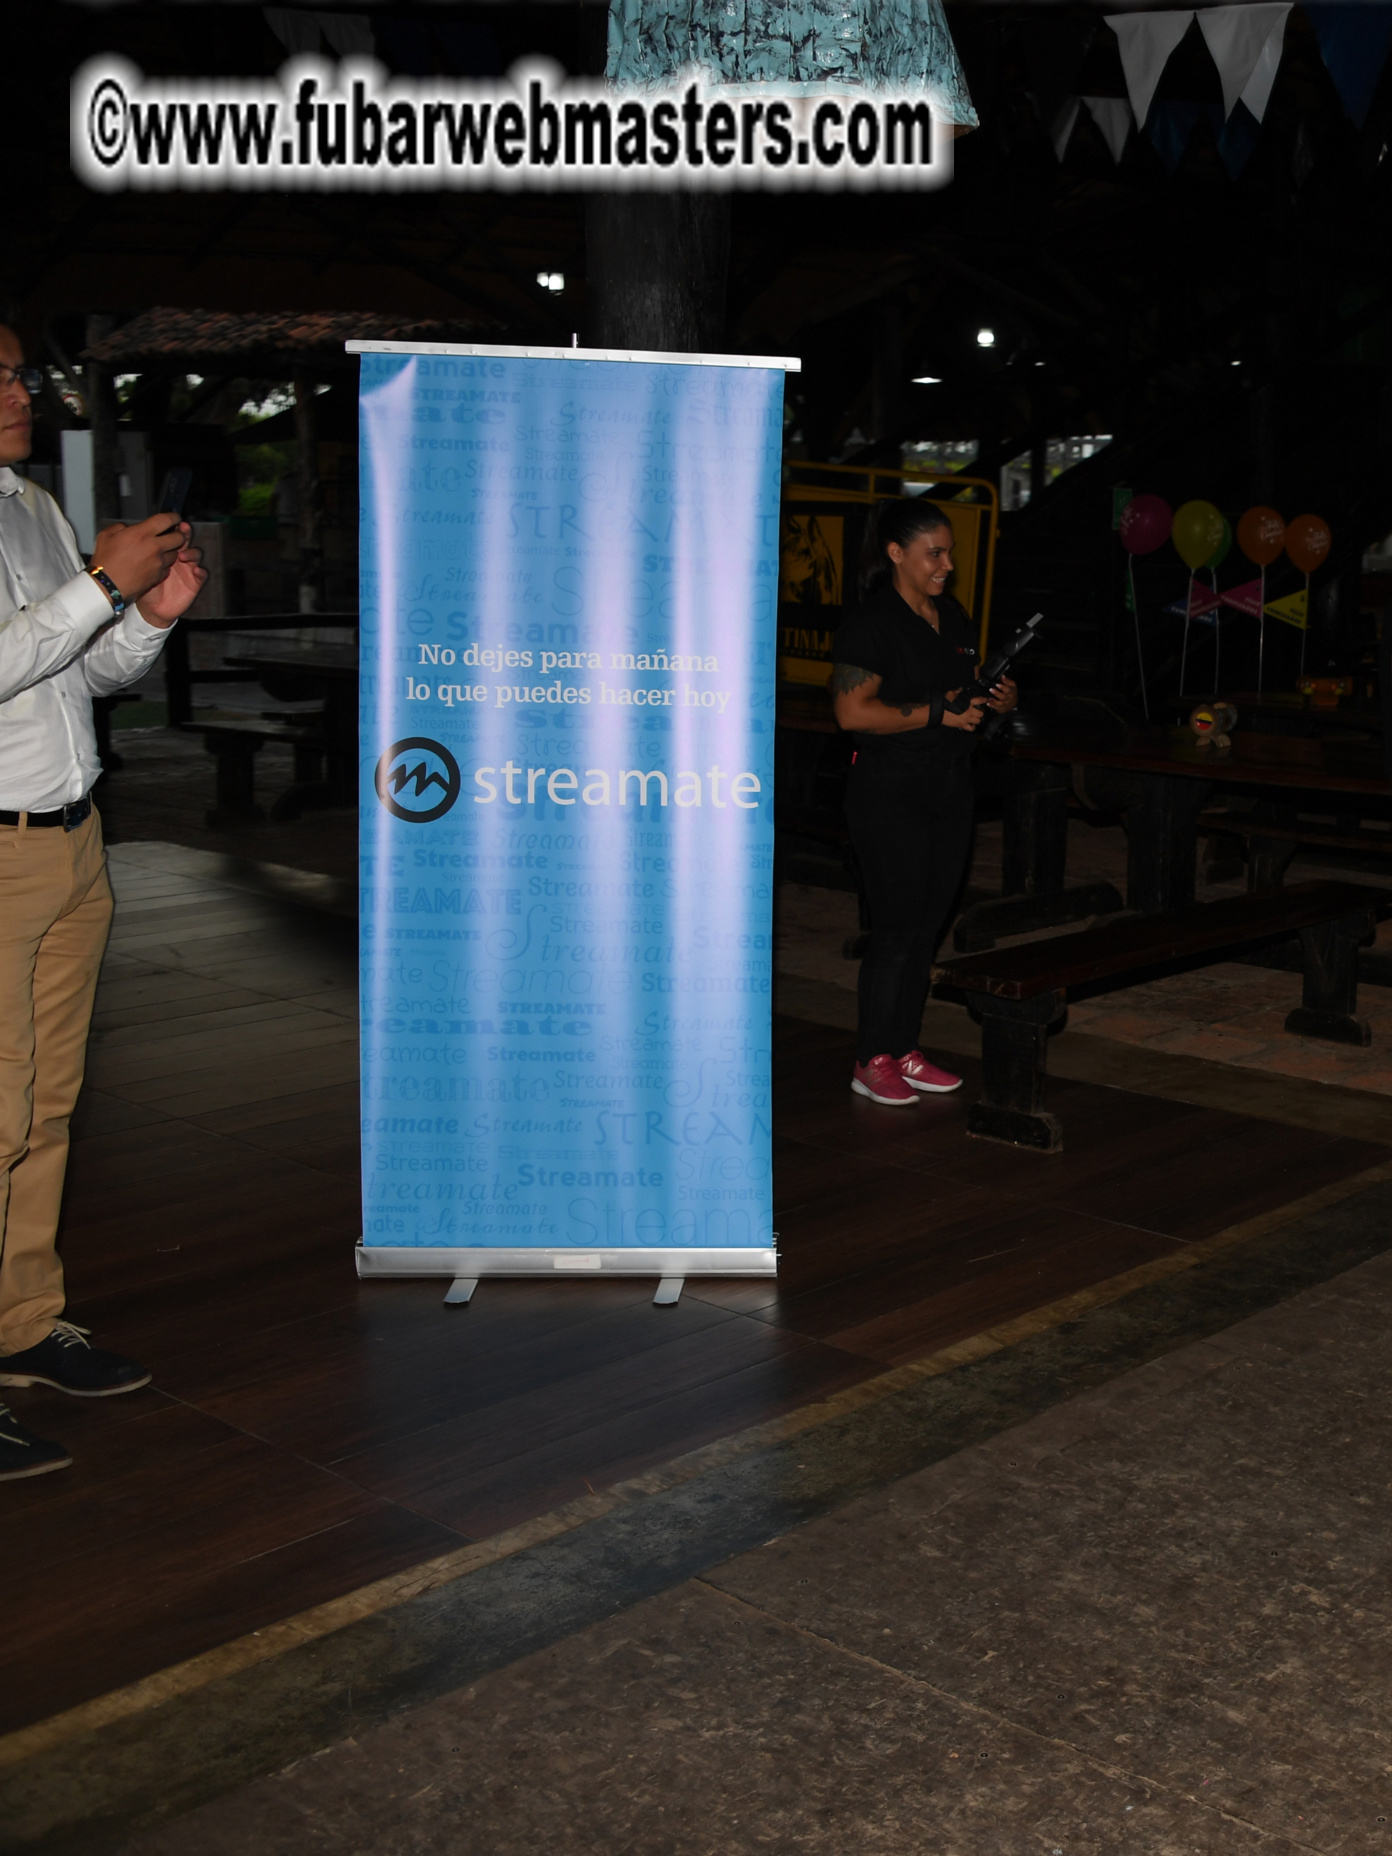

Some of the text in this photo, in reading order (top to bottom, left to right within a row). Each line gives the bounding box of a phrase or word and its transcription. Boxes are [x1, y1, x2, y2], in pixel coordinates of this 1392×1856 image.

[418, 644, 456, 668] No
[463, 642, 533, 673] dejes
[540, 649, 602, 674] para
[610, 648, 720, 674] mañana
[406, 677, 431, 701] lo
[437, 682, 488, 707] que
[494, 680, 592, 709] puedes
[599, 681, 676, 707] hacer
[684, 683, 732, 714] hoy
[473, 760, 762, 810] streamate
[375, 1152, 489, 1173] Streamate
[517, 1162, 665, 1189] Streamate
